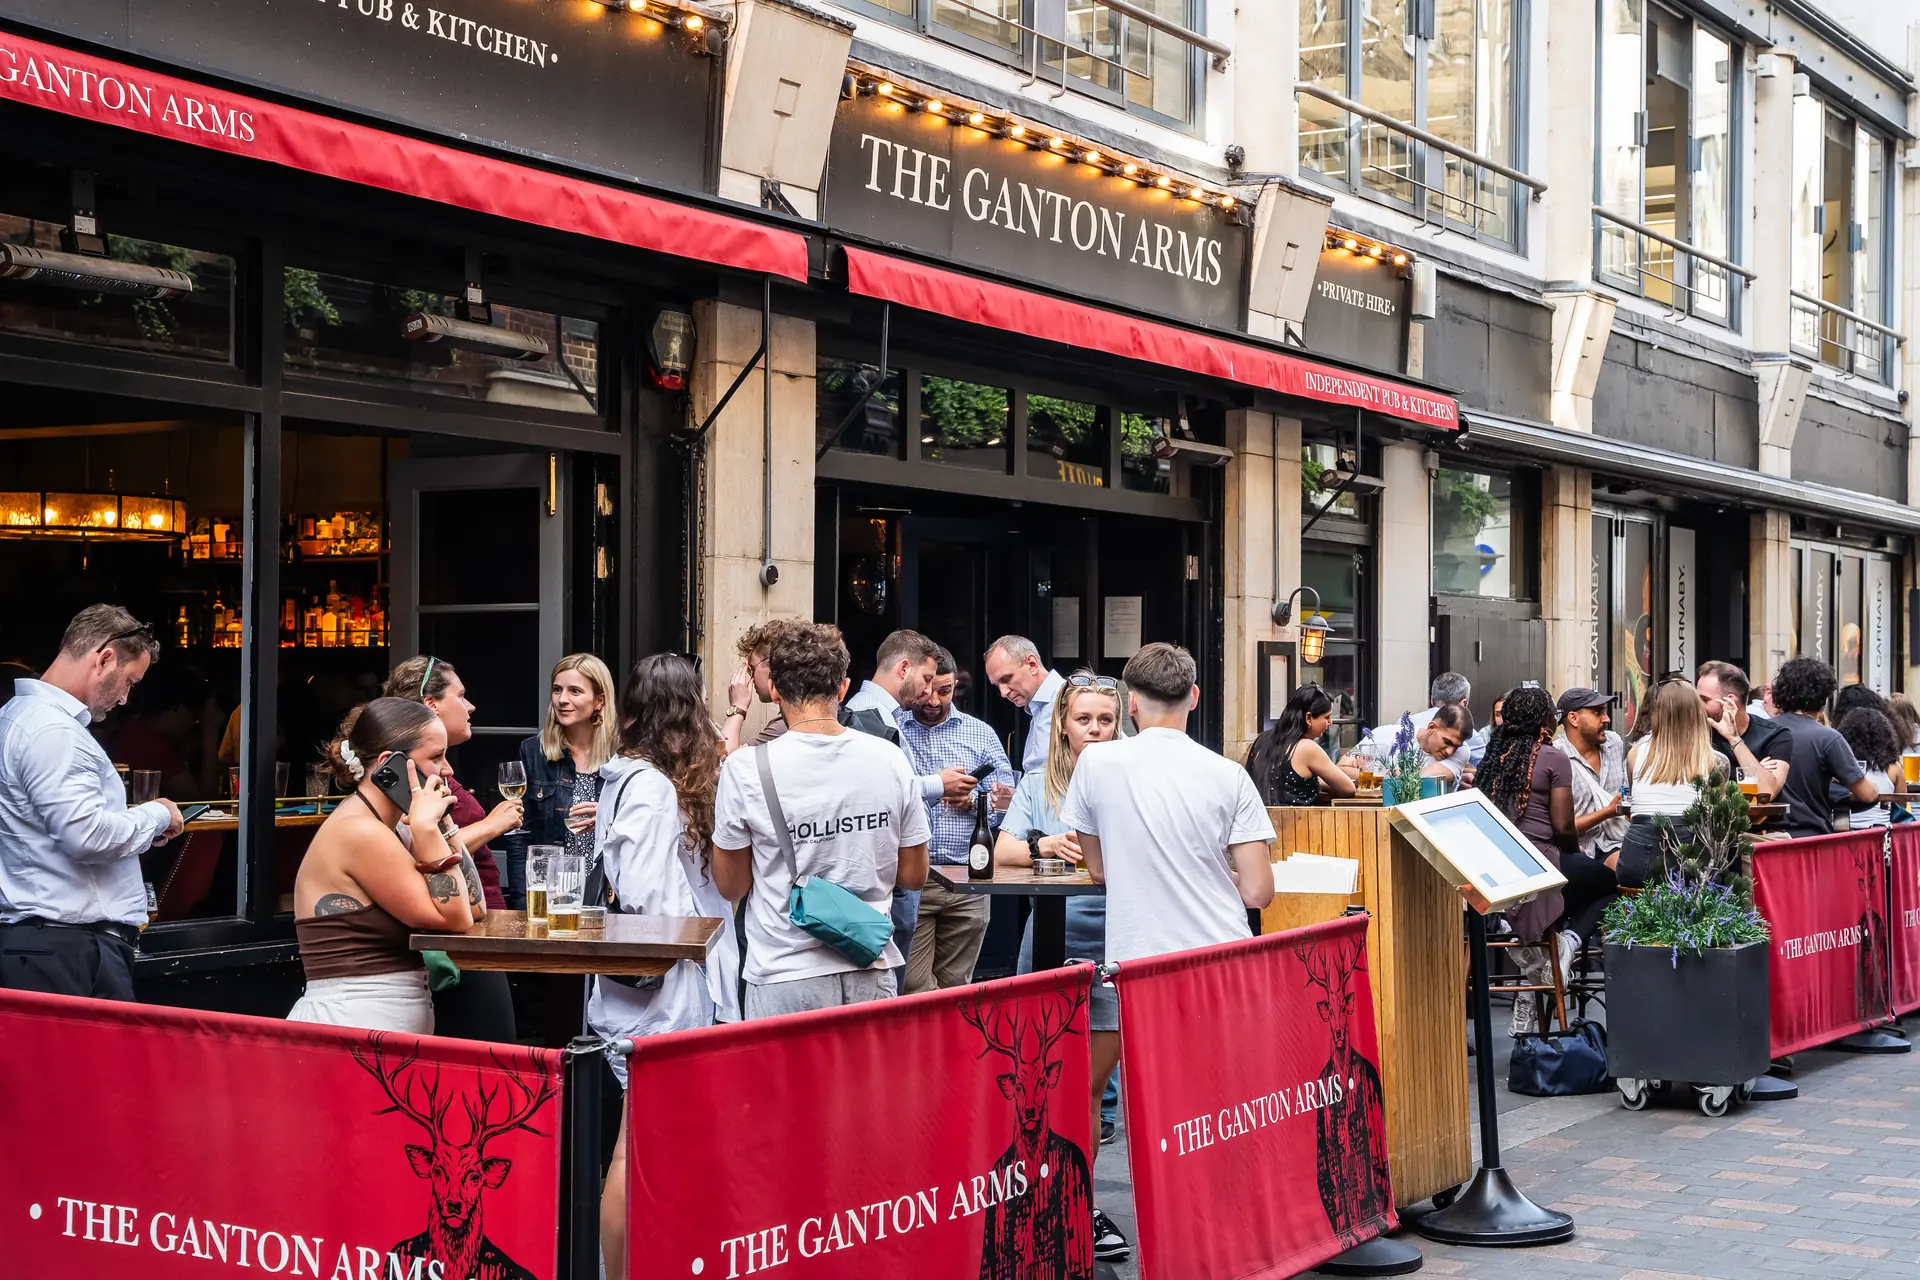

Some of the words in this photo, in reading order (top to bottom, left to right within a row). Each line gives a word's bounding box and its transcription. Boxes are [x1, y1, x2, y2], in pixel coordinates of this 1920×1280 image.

[401, 2, 420, 30] &
[427, 8, 548, 69] KITCHEN
[0, 48, 152, 118] GANTON
[162, 93, 255, 142] ARMS
[861, 133, 951, 211] THE
[962, 167, 1126, 260] GANTON
[1129, 218, 1222, 286] ARMS
[1322, 280, 1365, 308] PRIVATE
[1365, 293, 1391, 316] HIRE
[1304, 371, 1380, 403] INDEPENDENT
[1381, 388, 1400, 408] PUB
[1401, 394, 1410, 411] &
[1410, 396, 1454, 421] KITCHEN
[1591, 554, 1599, 669] CARNABY.
[1678, 564, 1686, 672] CARNABY.
[1785, 937, 1804, 959] THE
[1804, 930, 1837, 956] GANTON
[1838, 925, 1861, 948] ARMS
[1173, 1114, 1214, 1156] THE
[1218, 1088, 1291, 1141] GANTON
[1294, 1073, 1343, 1115] ARMS
[57, 1196, 139, 1247] THE
[149, 1212, 324, 1279] GANTON
[720, 1224, 789, 1280] THE
[798, 1187, 939, 1258] GANTON
[948, 1160, 1028, 1220] ARMS
